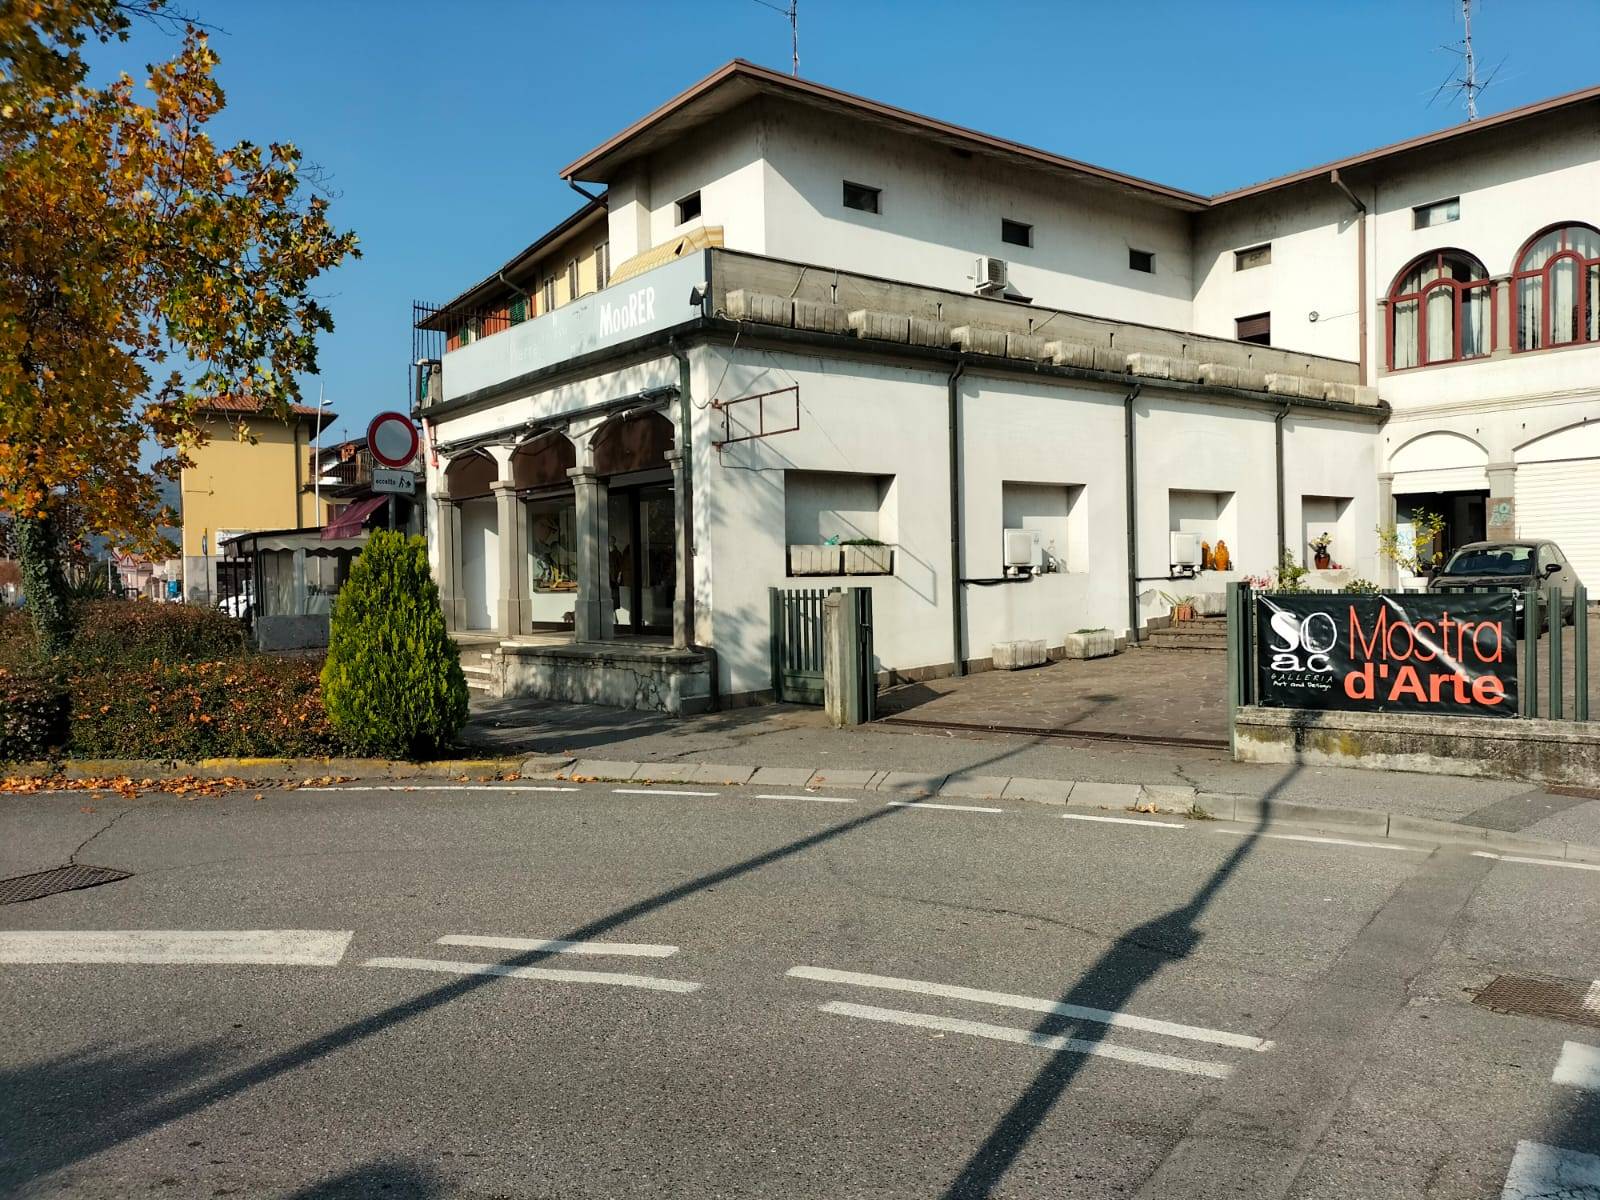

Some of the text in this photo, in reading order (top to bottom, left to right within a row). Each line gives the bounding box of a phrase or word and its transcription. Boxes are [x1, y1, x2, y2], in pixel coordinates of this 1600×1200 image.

[1349, 604, 1502, 663] Mostra
[1270, 673, 1333, 683] GALLERIA
[1344, 662, 1505, 705] d'Arte
